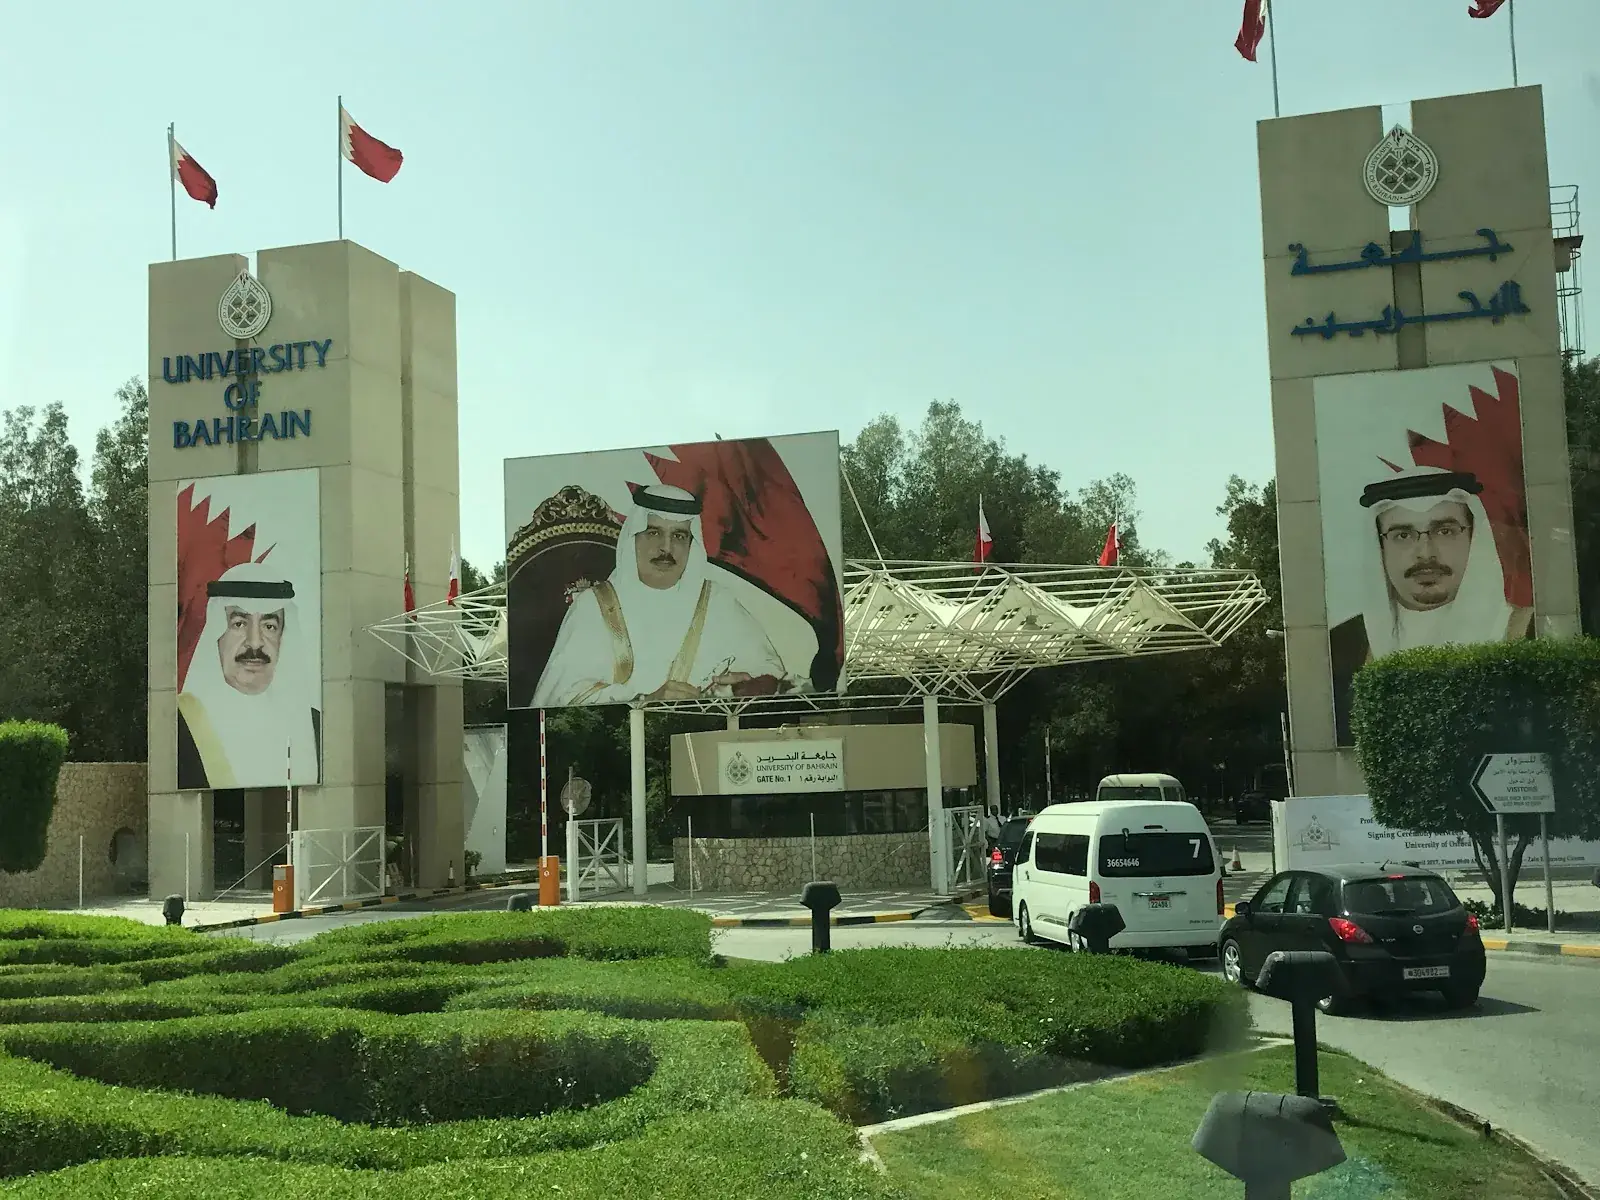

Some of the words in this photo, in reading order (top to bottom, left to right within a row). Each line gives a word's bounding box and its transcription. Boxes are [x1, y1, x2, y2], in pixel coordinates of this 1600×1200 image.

[1372, 184, 1400, 201] BAHRAIN
[1288, 228, 1514, 276] جامعة
[1291, 280, 1531, 340] البحرين
[163, 338, 333, 384] UNIVERSITY
[223, 380, 263, 411] OF
[173, 409, 312, 449] BAHRAIN
[756, 751, 799, 763] البحرين
[801, 751, 837, 761] جامعة
[756, 764, 794, 772] UNIVERSITY
[795, 763, 805, 771] OF
[806, 762, 838, 770] BAHRAIN
[756, 775, 774, 783] GATE
[775, 775, 786, 783] No.
[805, 774, 816, 783] رقم
[816, 774, 838, 783] البوابة
[1367, 831, 1396, 840] Signing
[1188, 838, 1201, 859] 7
[1405, 841, 1439, 850] University
[1441, 840, 1448, 848] of
[1106, 857, 1140, 868] 36654646
